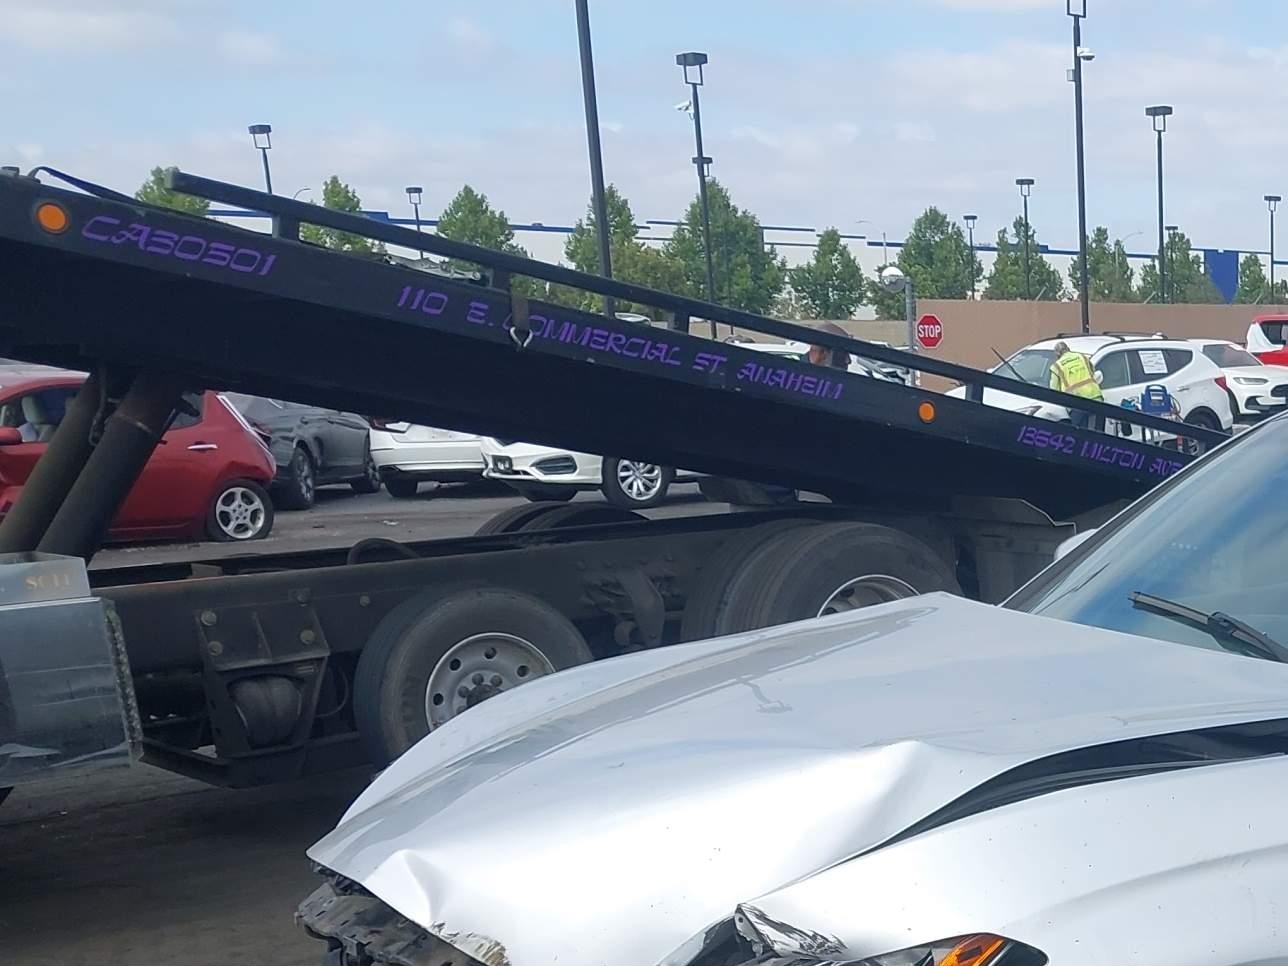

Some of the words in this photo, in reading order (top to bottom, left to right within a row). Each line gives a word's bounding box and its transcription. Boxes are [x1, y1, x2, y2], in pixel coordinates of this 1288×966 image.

[397, 285, 449, 316] 110
[465, 301, 495, 327] E.
[692, 352, 728, 377] ST.
[736, 360, 844, 400] ANAHEIM
[918, 324, 941, 338] STOP
[1080, 440, 1145, 470] MILTON
